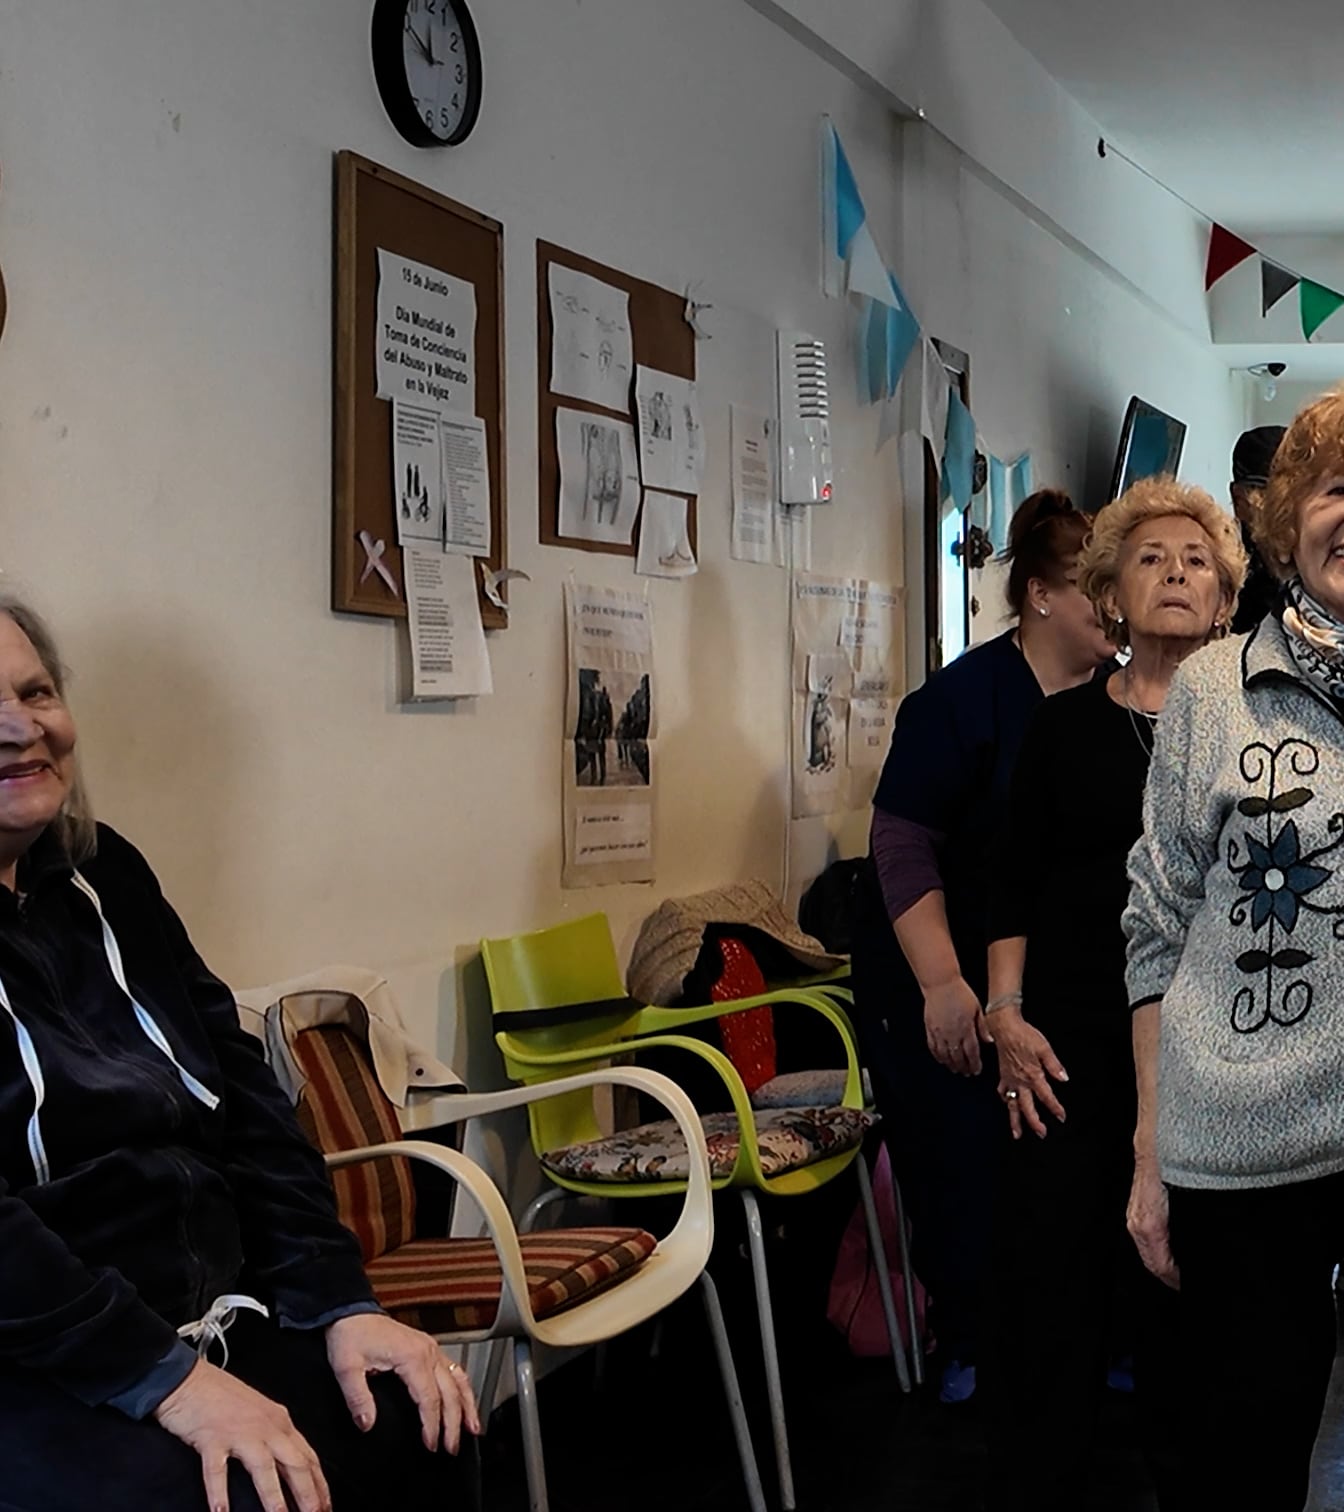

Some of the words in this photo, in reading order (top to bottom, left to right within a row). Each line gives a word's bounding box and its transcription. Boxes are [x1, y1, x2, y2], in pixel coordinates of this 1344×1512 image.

[441, 8, 446, 26] 1
[450, 32, 458, 53] 2
[455, 64, 464, 85] 3
[452, 92, 460, 110] 4
[425, 110, 434, 129] 6
[440, 107, 449, 128] 5
[402, 267, 412, 283] 15
[413, 273, 422, 288] de
[424, 276, 449, 297] Junio
[411, 311, 444, 335] Mundial
[445, 323, 456, 339] de
[384, 323, 408, 345] Toma
[410, 334, 420, 349] de
[422, 336, 467, 364] Conciencia
[384, 347, 398, 364] del
[400, 351, 426, 373] Abuso
[427, 363, 433, 378] y
[434, 361, 468, 385] Maltrato
[405, 378, 416, 391] en
[418, 379, 425, 394] la
[426, 381, 449, 402] Vejez
